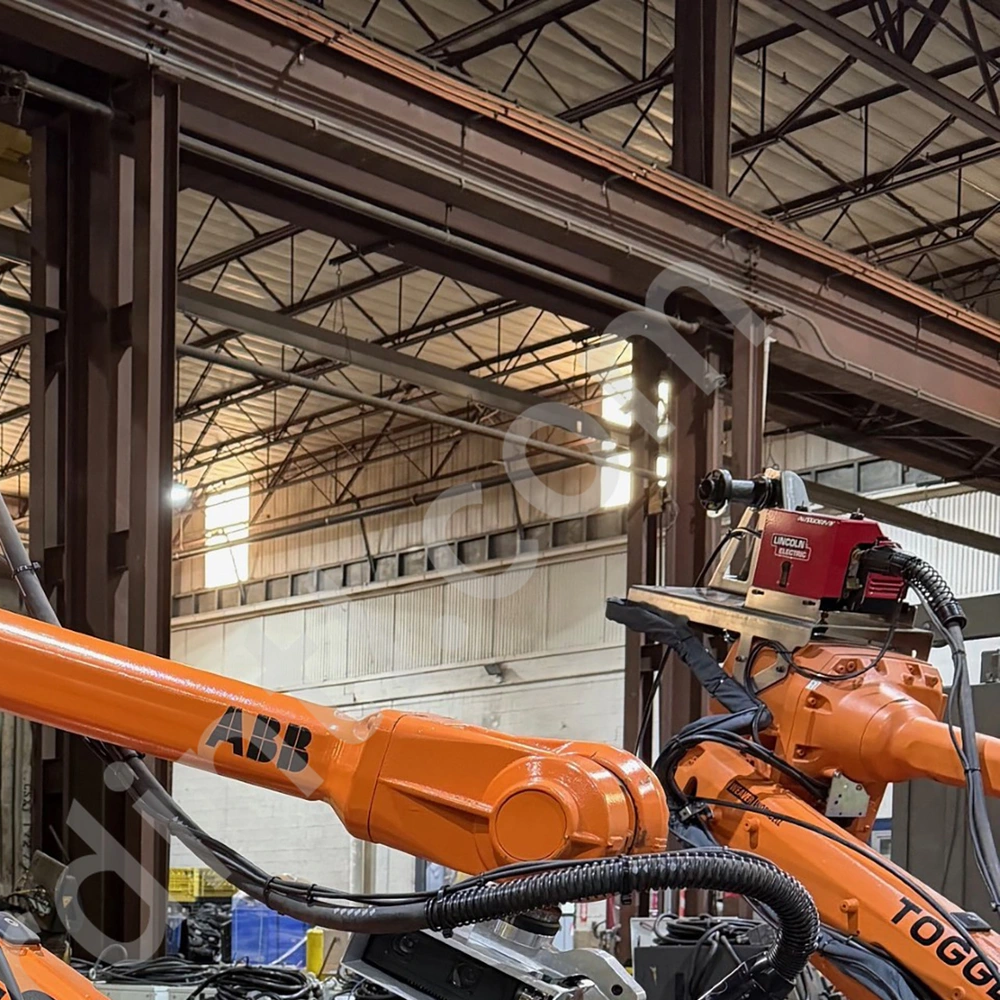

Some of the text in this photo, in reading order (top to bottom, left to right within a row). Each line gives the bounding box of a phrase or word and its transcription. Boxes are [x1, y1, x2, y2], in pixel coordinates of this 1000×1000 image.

[773, 535, 806, 549] LINCOLN
[778, 547, 807, 559] ELECTRIC
[205, 705, 312, 773] ABB
